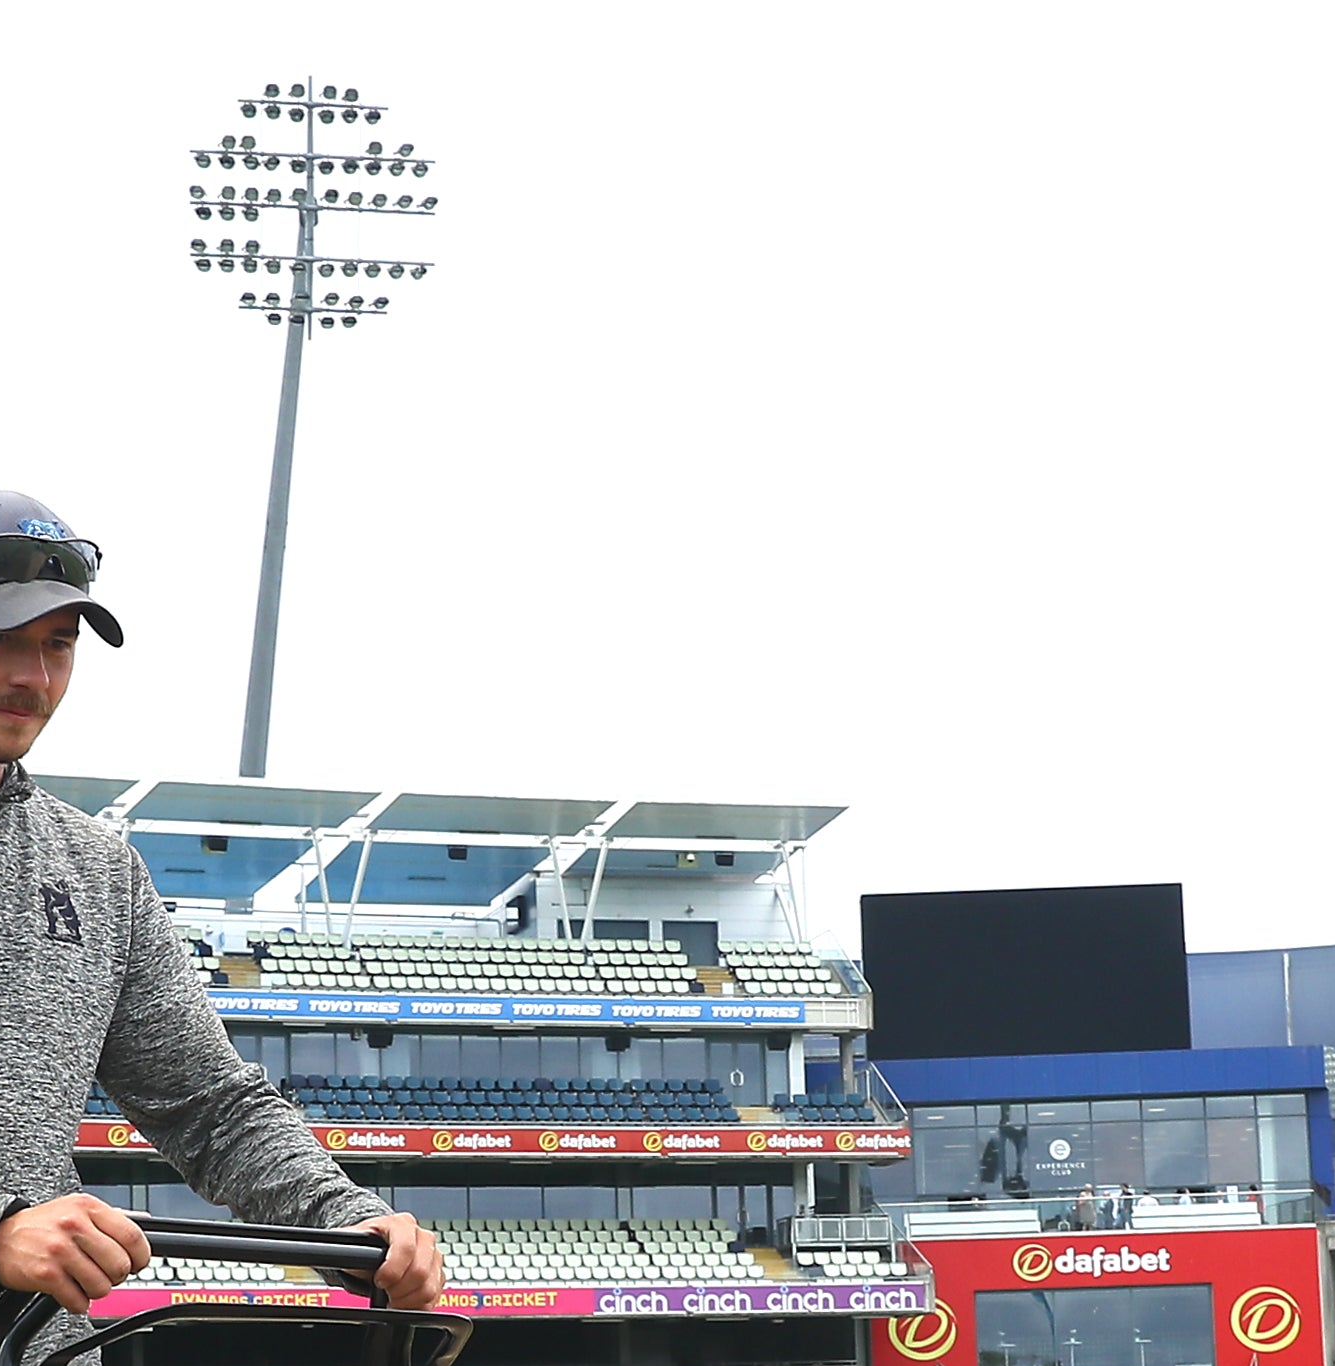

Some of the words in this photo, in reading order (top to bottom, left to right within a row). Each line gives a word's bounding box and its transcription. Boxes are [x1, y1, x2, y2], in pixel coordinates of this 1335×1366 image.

[251, 998, 299, 1011] TIRES
[309, 999, 353, 1013] TOYO
[354, 1001, 400, 1014] TIRES
[411, 1001, 456, 1014] TOYO
[456, 1002, 502, 1015] TIRES
[512, 1003, 555, 1016] TOYO
[556, 1003, 602, 1016] TIRES
[611, 1004, 655, 1018] TOYO
[655, 1005, 702, 1018] TIRES
[711, 1004, 754, 1018] TOYO
[754, 1006, 801, 1019] TIRES
[347, 1133, 405, 1148] dafabet
[453, 1133, 511, 1149] dafabet
[559, 1134, 616, 1149] dafabet
[664, 1134, 720, 1150] dafabet
[767, 1134, 824, 1150] dafabet
[855, 1134, 911, 1149] dafabet
[1054, 1245, 1171, 1278] dafabet
[253, 1293, 330, 1307] CRICKET
[435, 1293, 479, 1307] AMOS
[482, 1292, 558, 1307] CRICKET
[599, 1287, 668, 1313] cinch
[683, 1286, 752, 1312] cinch
[766, 1285, 835, 1312] cinch
[849, 1283, 916, 1311] cinch
